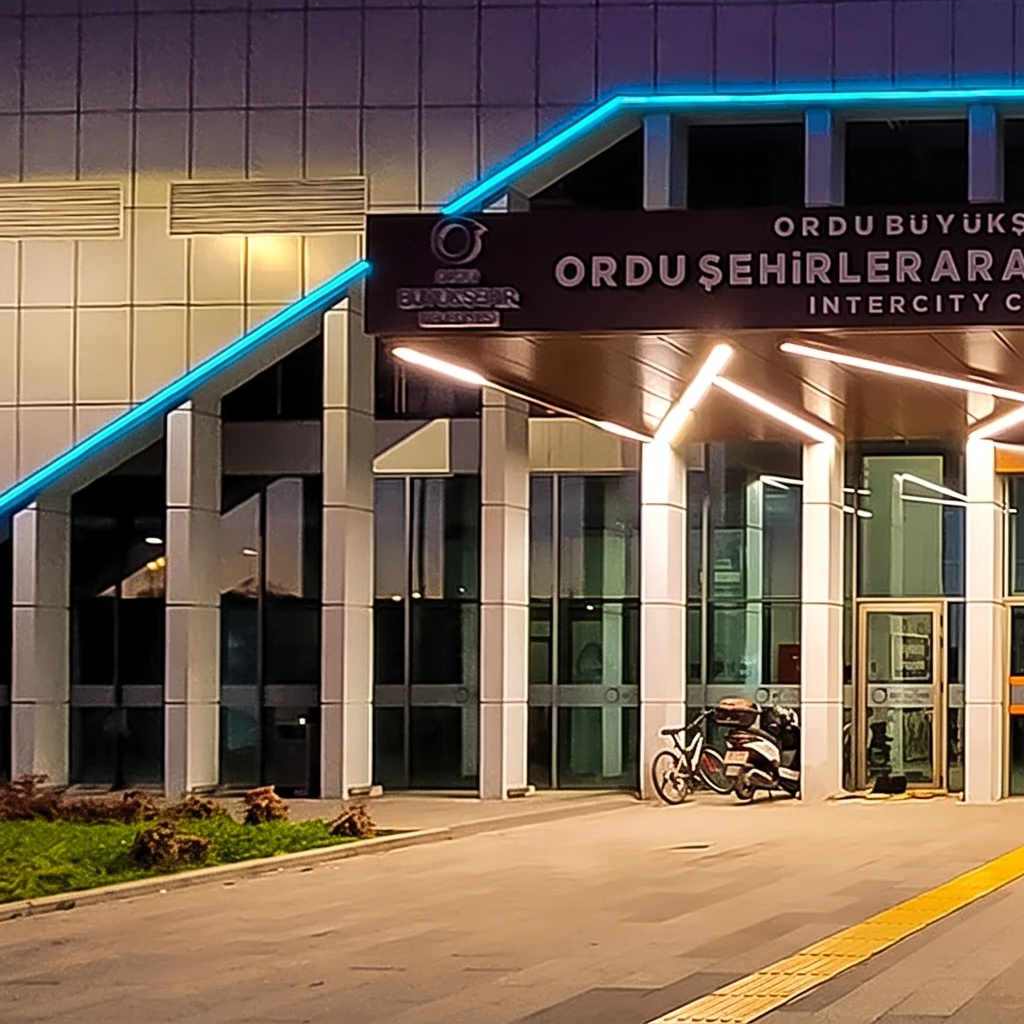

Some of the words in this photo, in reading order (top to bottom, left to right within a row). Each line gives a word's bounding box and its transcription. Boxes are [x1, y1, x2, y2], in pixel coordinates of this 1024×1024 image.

[774, 215, 874, 237] ORDU
[555, 254, 686, 288] ORDU
[809, 293, 989, 314] INTERCITY
